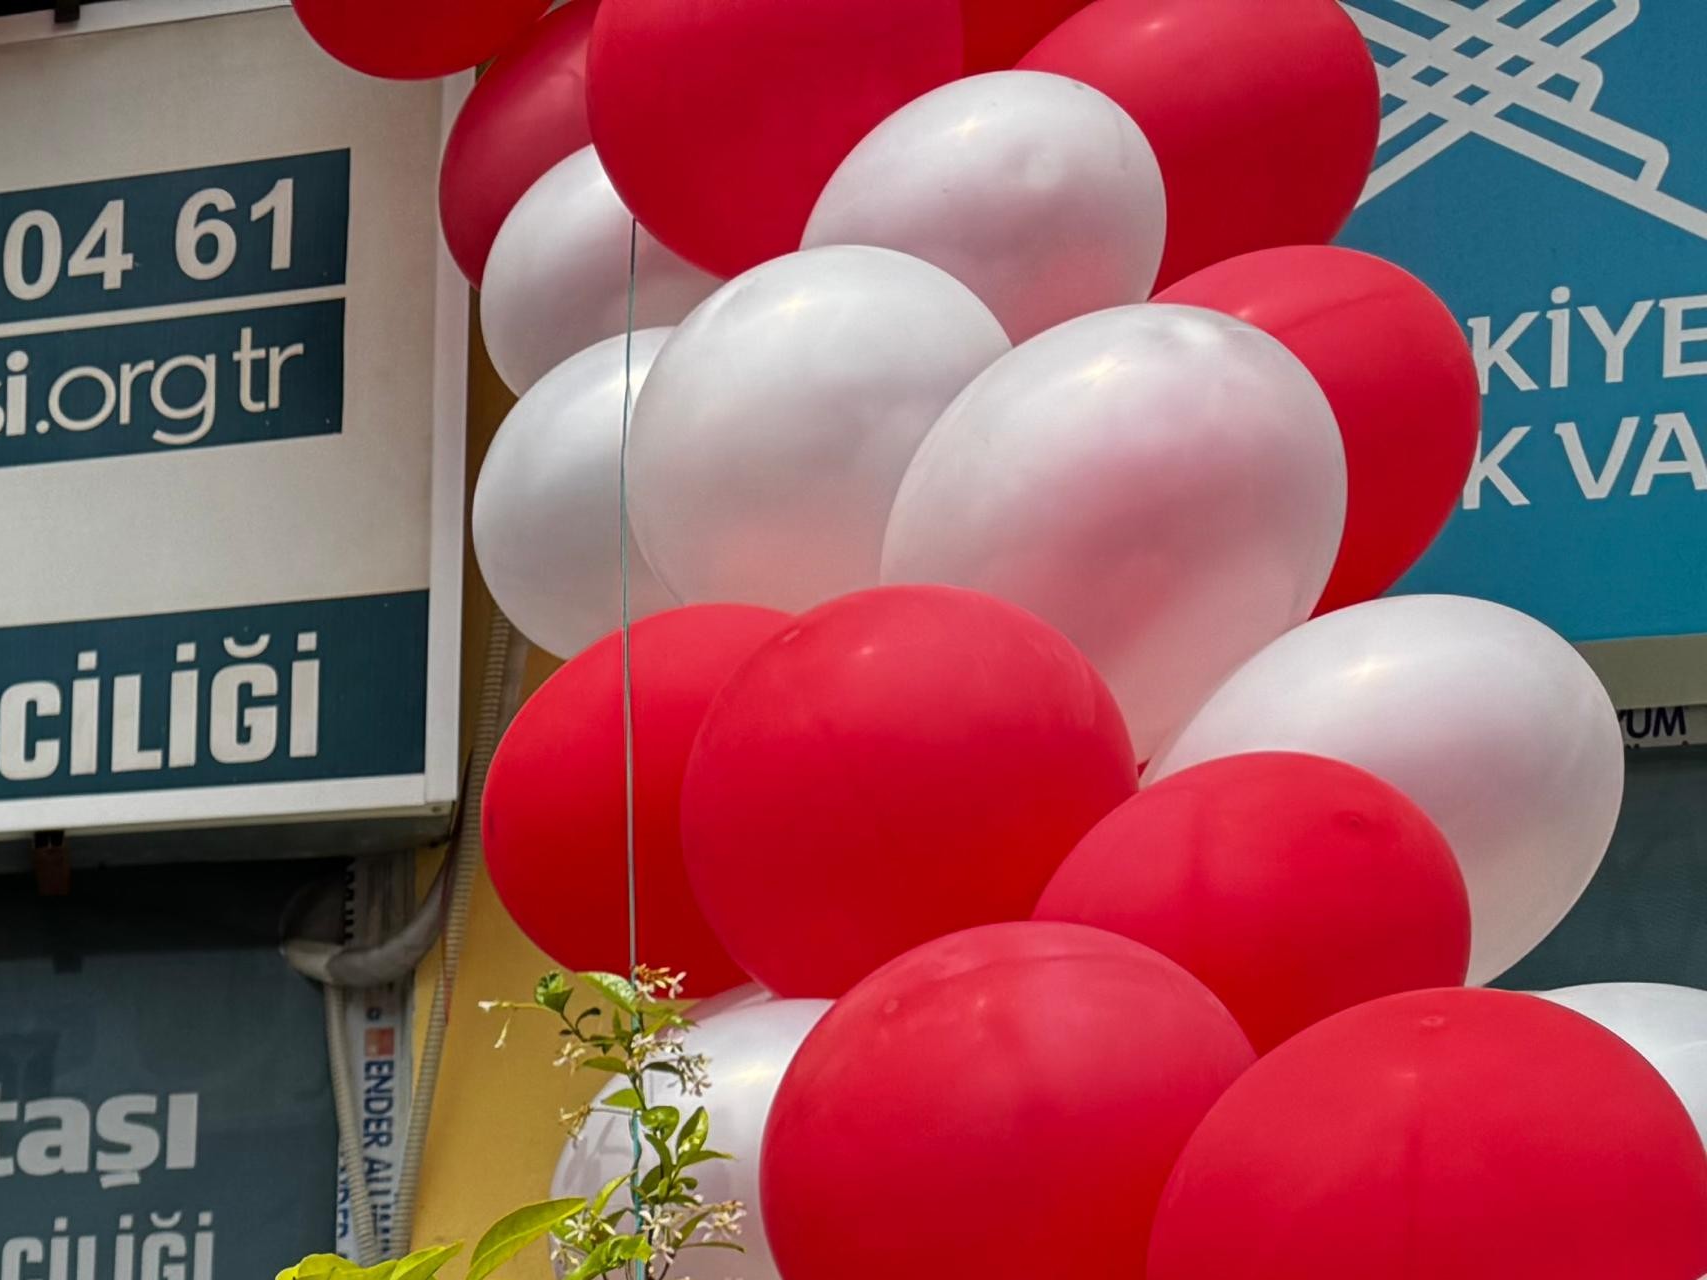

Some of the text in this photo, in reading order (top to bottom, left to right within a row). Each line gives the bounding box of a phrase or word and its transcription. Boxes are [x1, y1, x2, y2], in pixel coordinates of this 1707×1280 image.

[2, 199, 136, 303] 04
[174, 177, 297, 282] 61
[363, 1060, 394, 1149] ENDER
